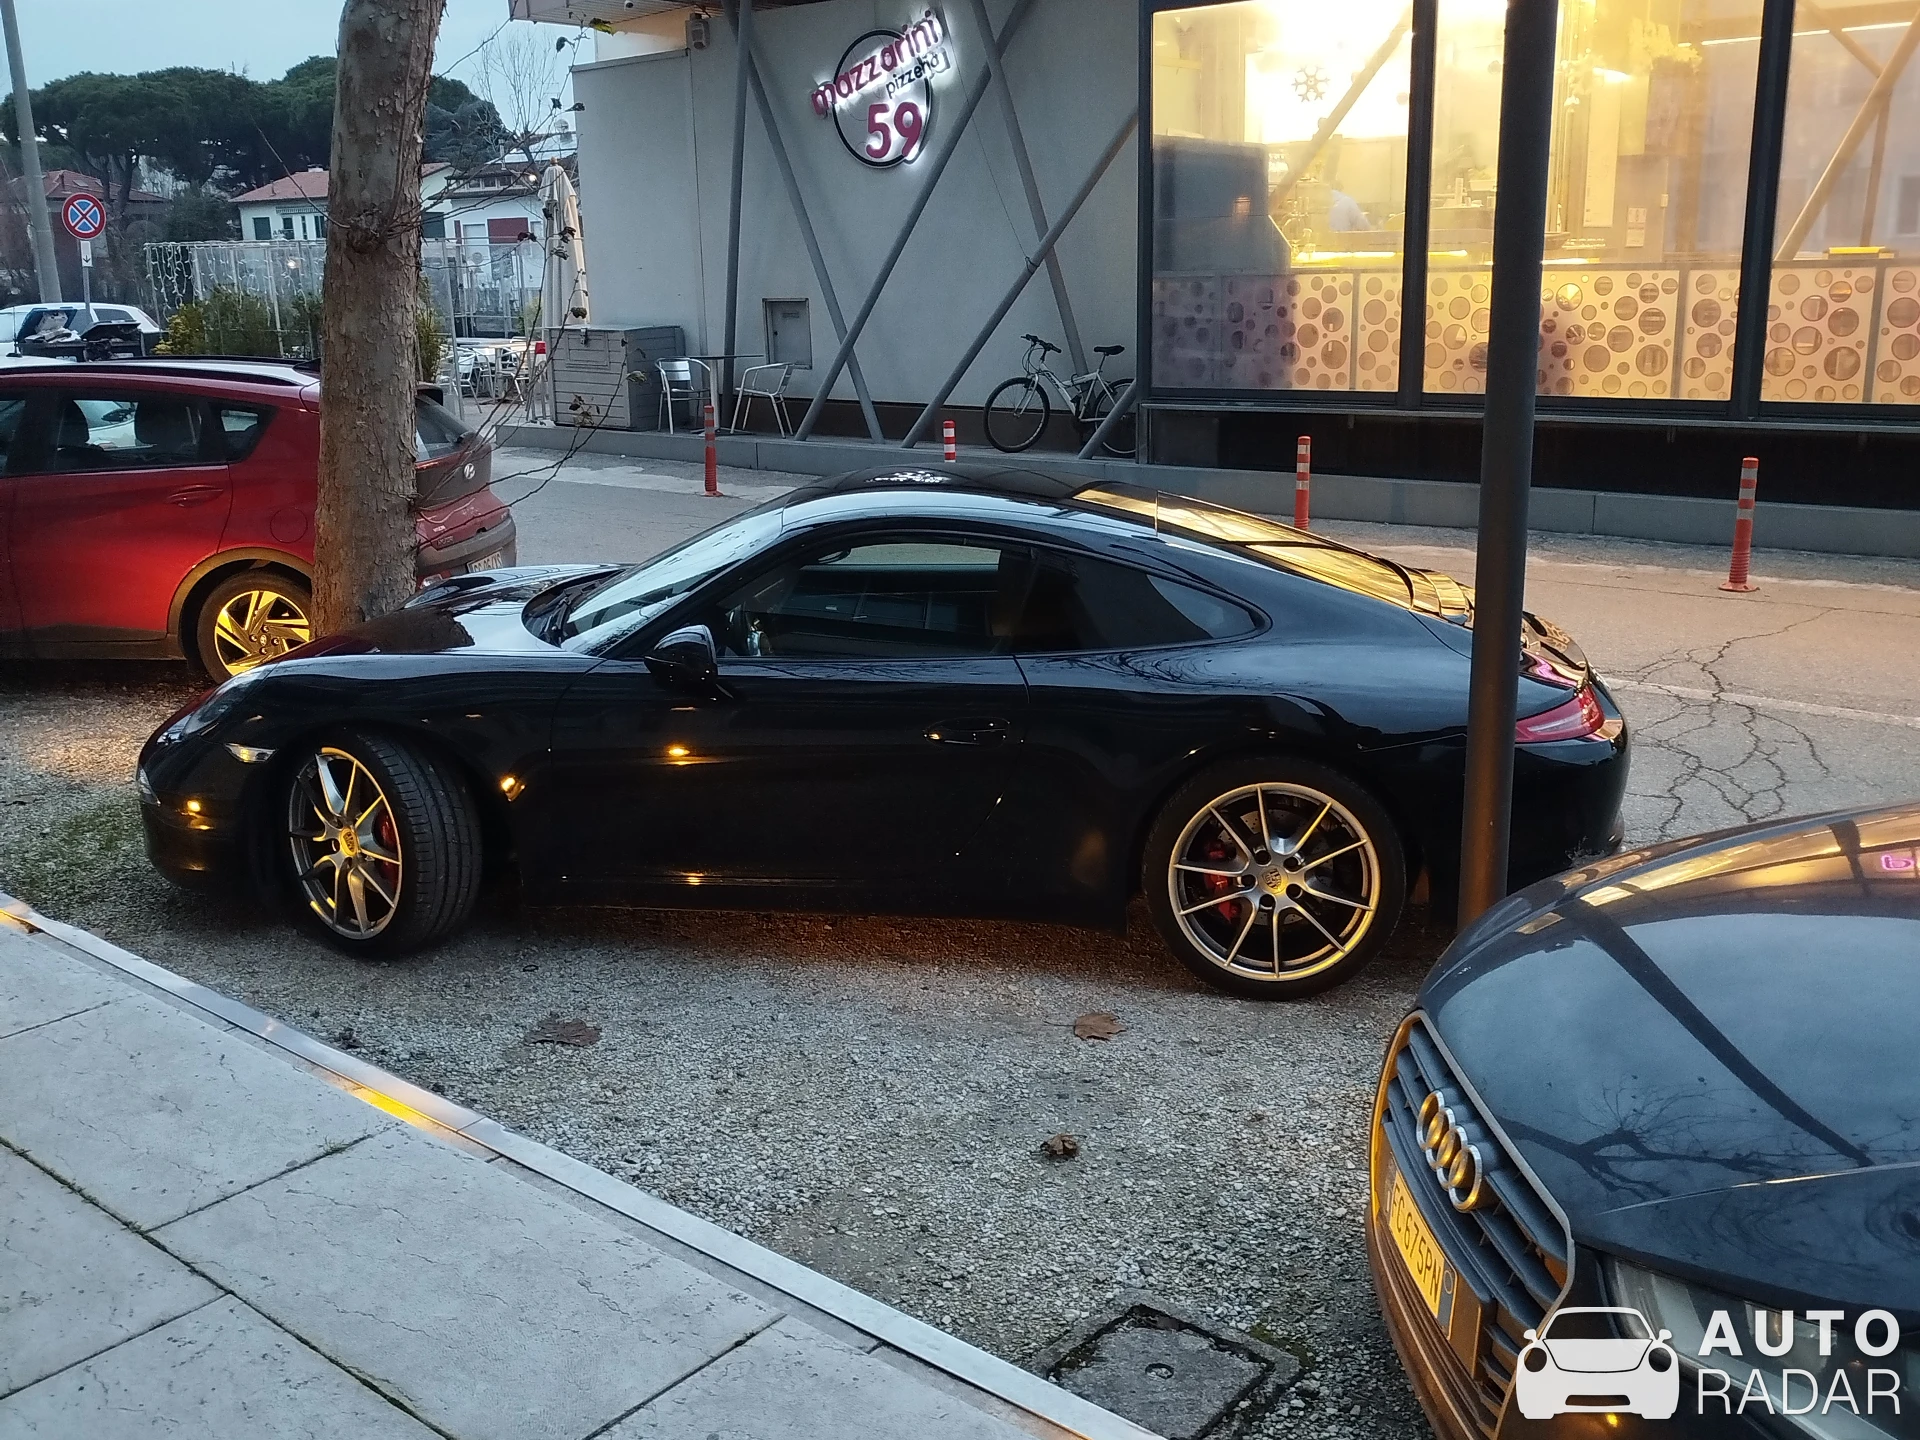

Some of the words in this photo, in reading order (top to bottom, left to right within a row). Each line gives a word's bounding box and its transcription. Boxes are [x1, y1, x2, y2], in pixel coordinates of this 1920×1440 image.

[811, 10, 939, 115] mazzarini
[886, 50, 942, 99] pizzeria
[866, 102, 922, 158] 59
[1404, 1212, 1441, 1303] 675PN
